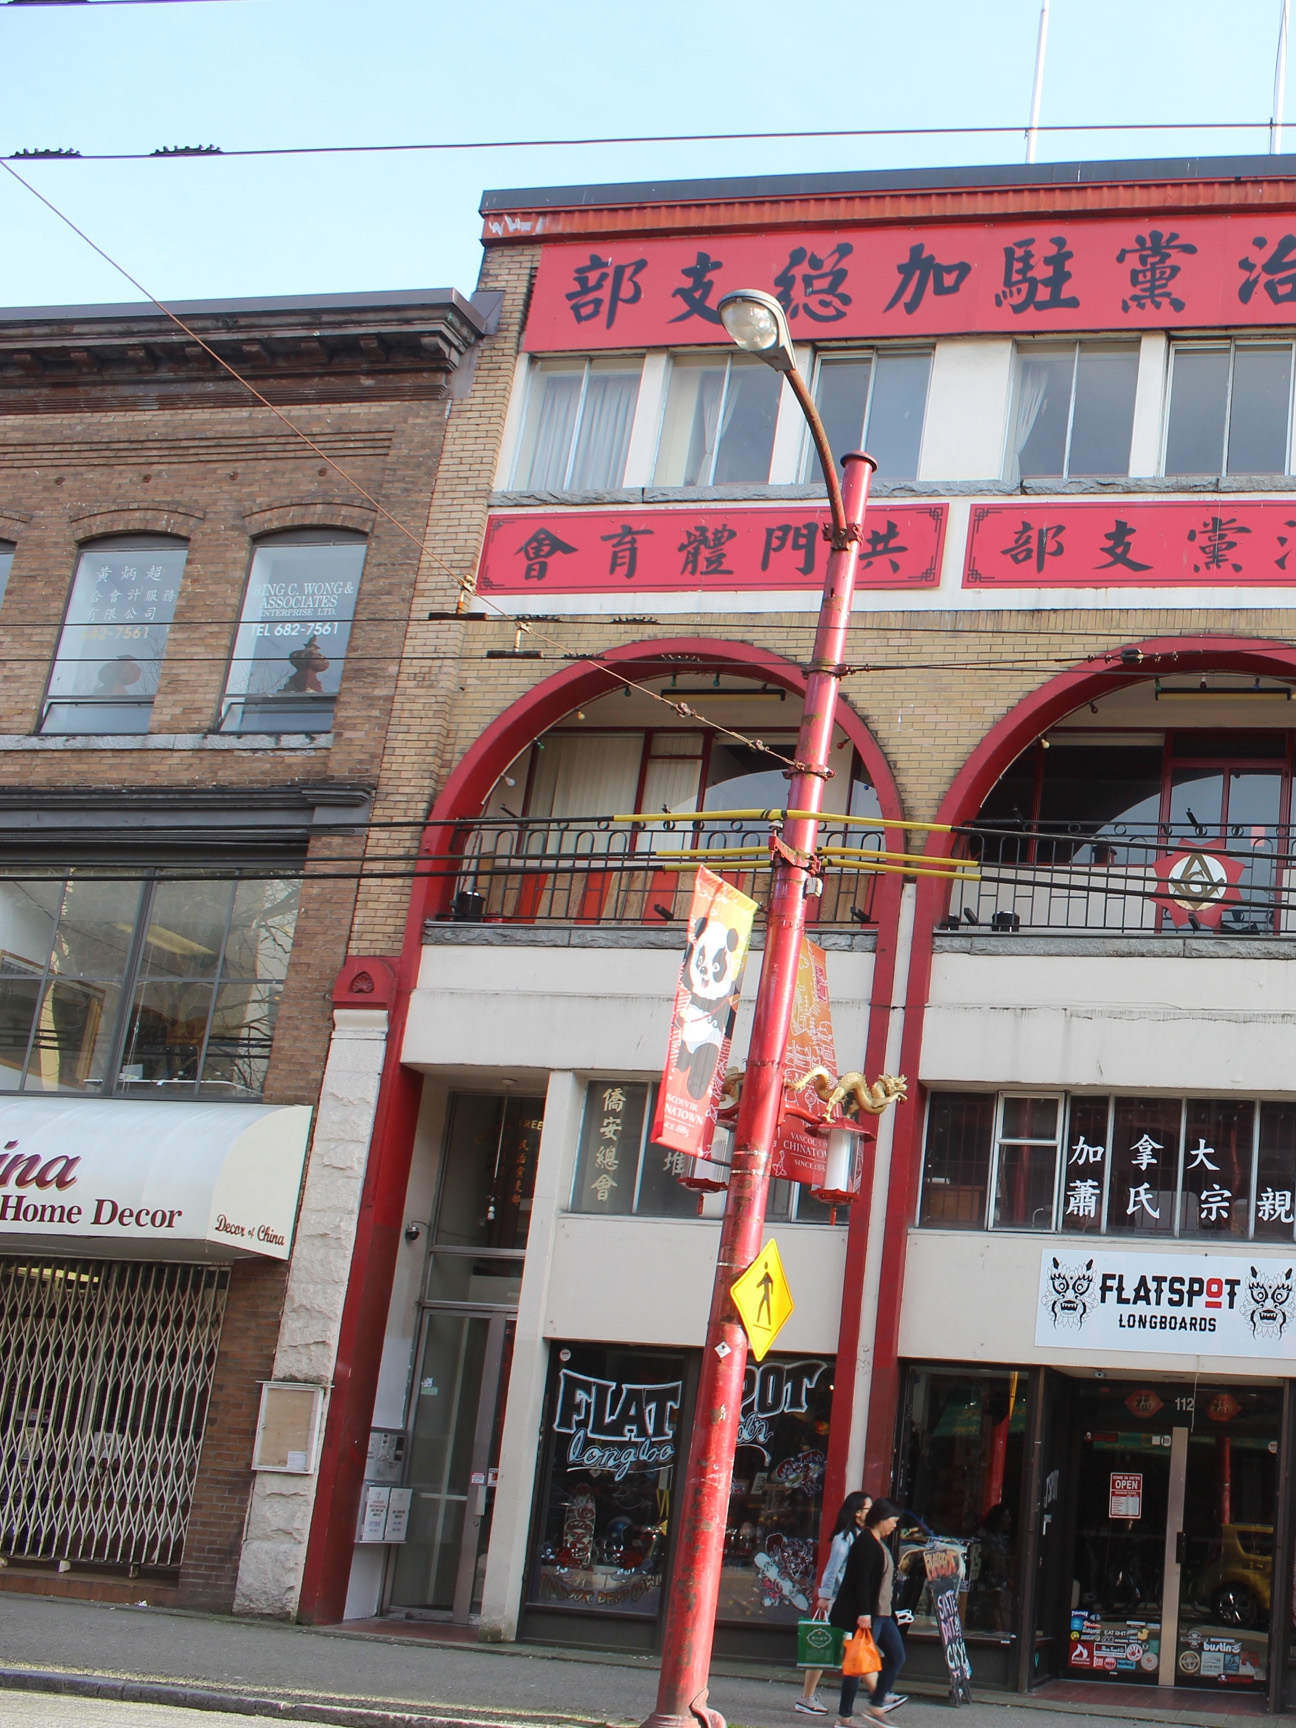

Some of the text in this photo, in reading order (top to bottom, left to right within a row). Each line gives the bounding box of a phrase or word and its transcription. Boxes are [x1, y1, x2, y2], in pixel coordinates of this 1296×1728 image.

[287, 582, 300, 596] C.
[303, 582, 344, 596] WONG
[344, 581, 355, 594] &
[259, 595, 338, 610] ASSOCIATES
[258, 607, 337, 618] ENTERPRISE LTD.
[81, 626, 150, 641] 682-7561
[251, 621, 340, 638] TEL 682-7561
[664, 1103, 704, 1126] NATOWN
[1068, 1134, 1221, 1171] 加拿大
[0, 1139, 82, 1192] ina
[1, 1195, 183, 1229] Home Decor
[214, 1213, 246, 1237] Decor
[256, 1224, 286, 1247] China
[1099, 1272, 1242, 1310] FLATSPOT
[1117, 1313, 1217, 1333] LONGBOARDS
[1175, 1397, 1195, 1411] 112
[1115, 1480, 1138, 1490] OPEN
